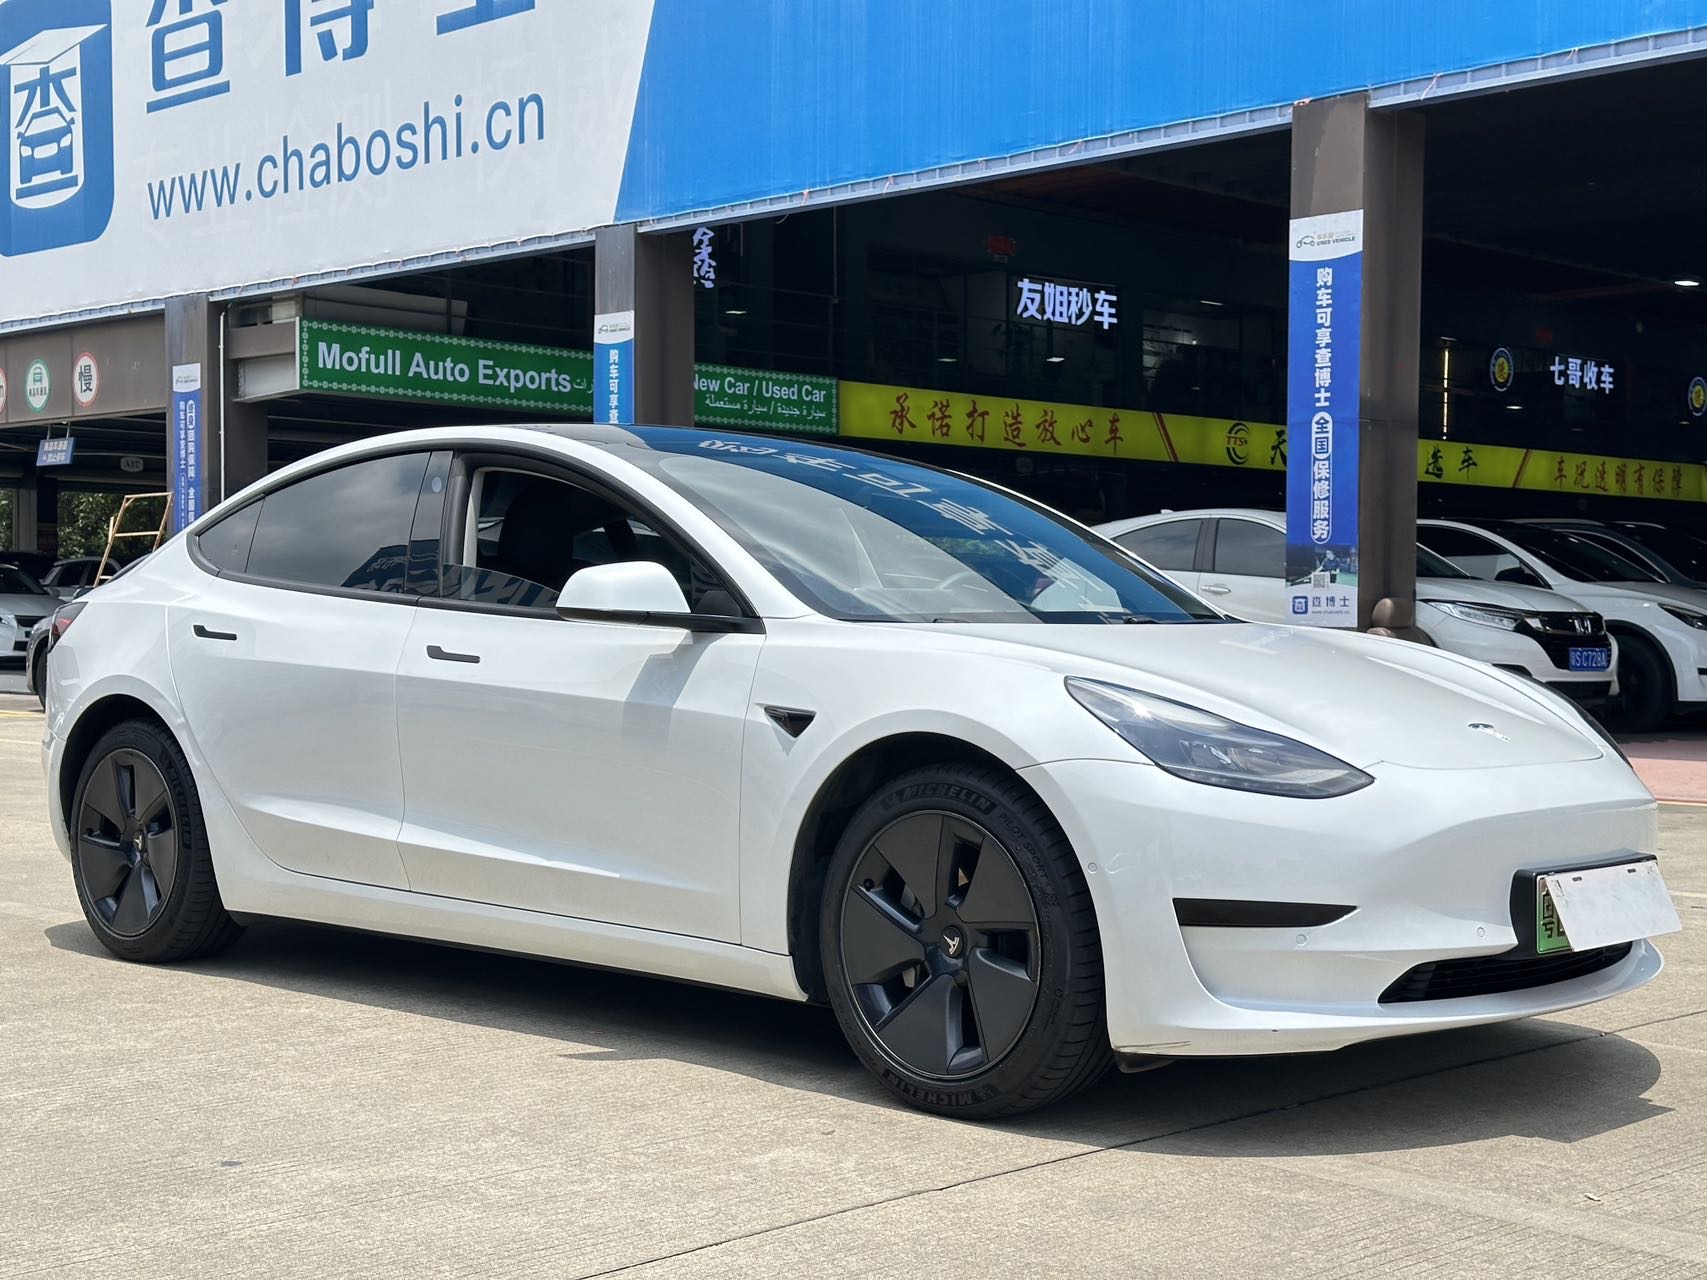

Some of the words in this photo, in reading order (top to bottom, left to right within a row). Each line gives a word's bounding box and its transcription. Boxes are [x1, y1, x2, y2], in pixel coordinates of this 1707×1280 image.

[147, 92, 546, 220] www.chaboshi.cn
[1016, 278, 1119, 330] 友姐秒车
[1314, 267, 1333, 407] 购车可享查博士
[78, 364, 93, 394] 慢
[317, 340, 402, 375] Mofull
[408, 351, 470, 383] Auto
[477, 360, 573, 394] Exports
[724, 376, 750, 396] Car
[762, 380, 798, 401] Used
[801, 385, 827, 403] Car
[1549, 356, 1615, 395] 七哥收车
[888, 391, 1126, 456] 承诺打造放心车
[1313, 416, 1331, 539] 全国保修服务
[1554, 455, 1683, 497] 车况透明有保障
[1312, 596, 1351, 608] 查博士
[903, 782, 991, 813] MICHELIN
[998, 812, 1025, 839] PILOT
[1022, 842, 1049, 881] SPORT
[887, 1072, 972, 1106] MICHELIN
